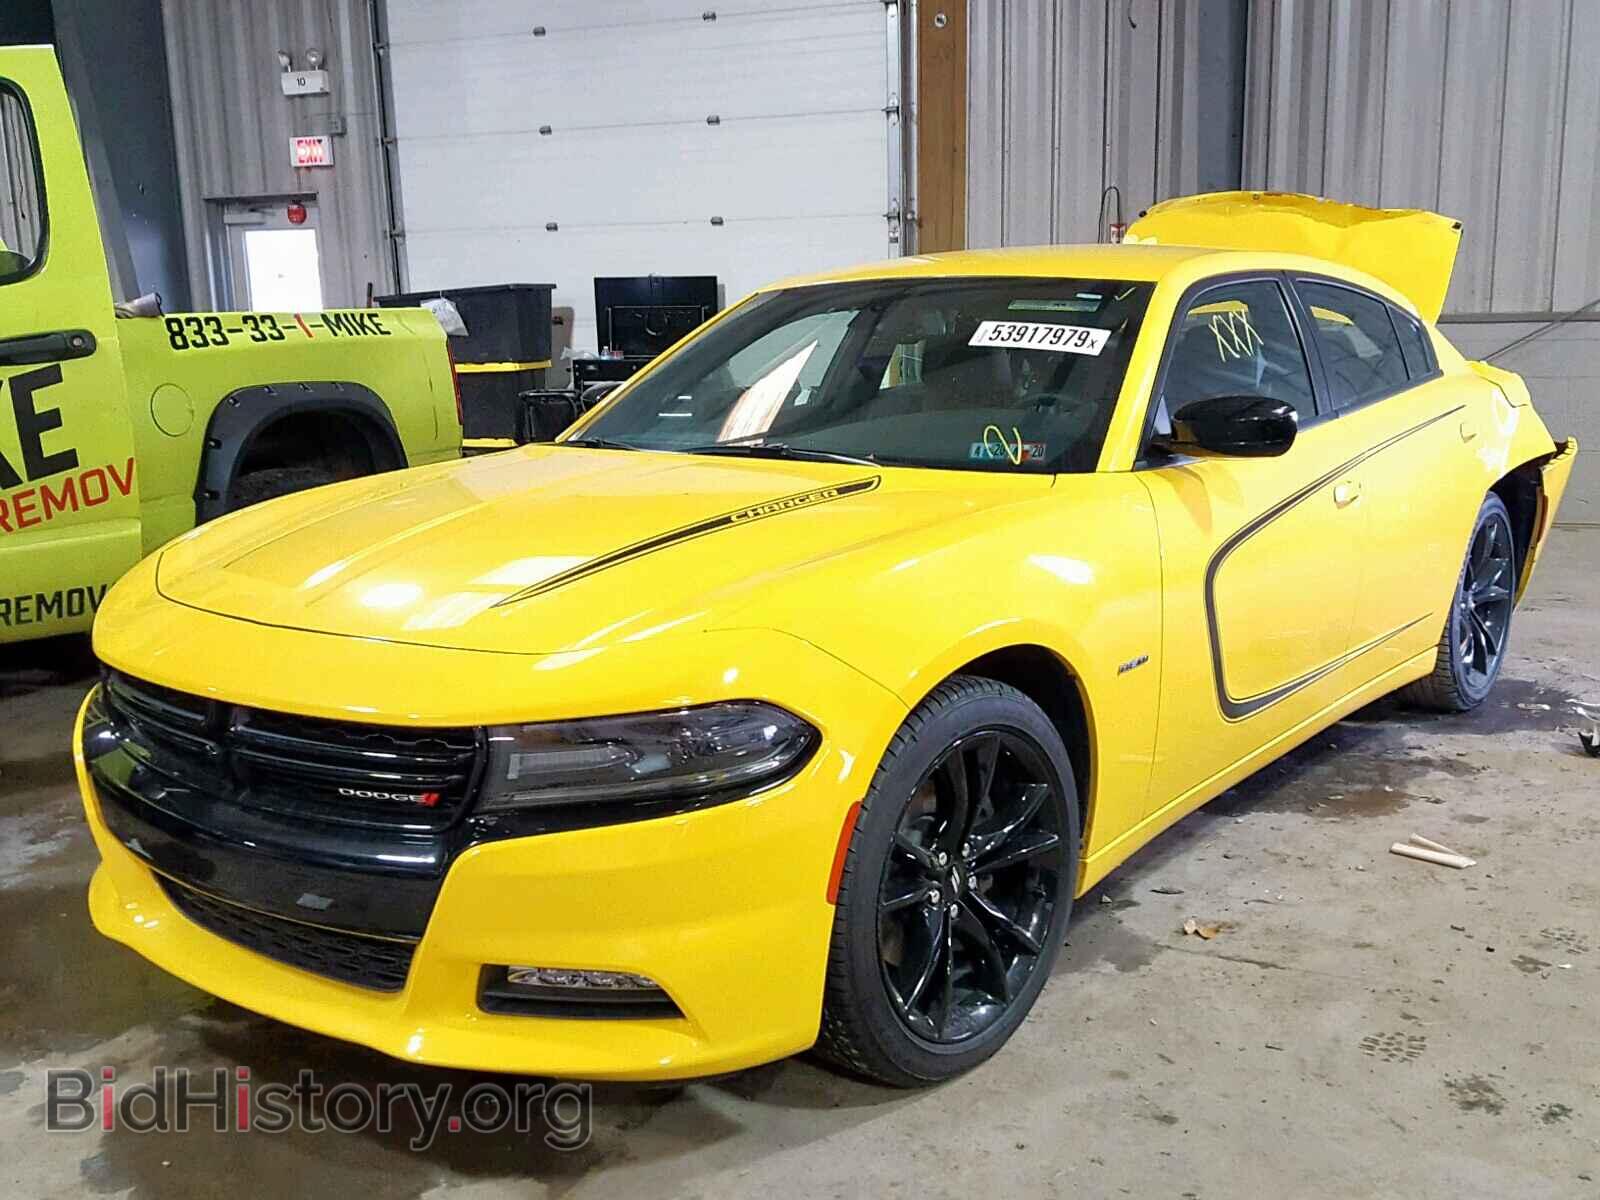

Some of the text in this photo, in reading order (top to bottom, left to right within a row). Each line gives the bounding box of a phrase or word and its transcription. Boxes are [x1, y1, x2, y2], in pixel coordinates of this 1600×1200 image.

[296, 77, 306, 87] 10
[296, 139, 324, 164] EXIT
[730, 489, 839, 522] CHARGER
[339, 787, 424, 802] DODGE
